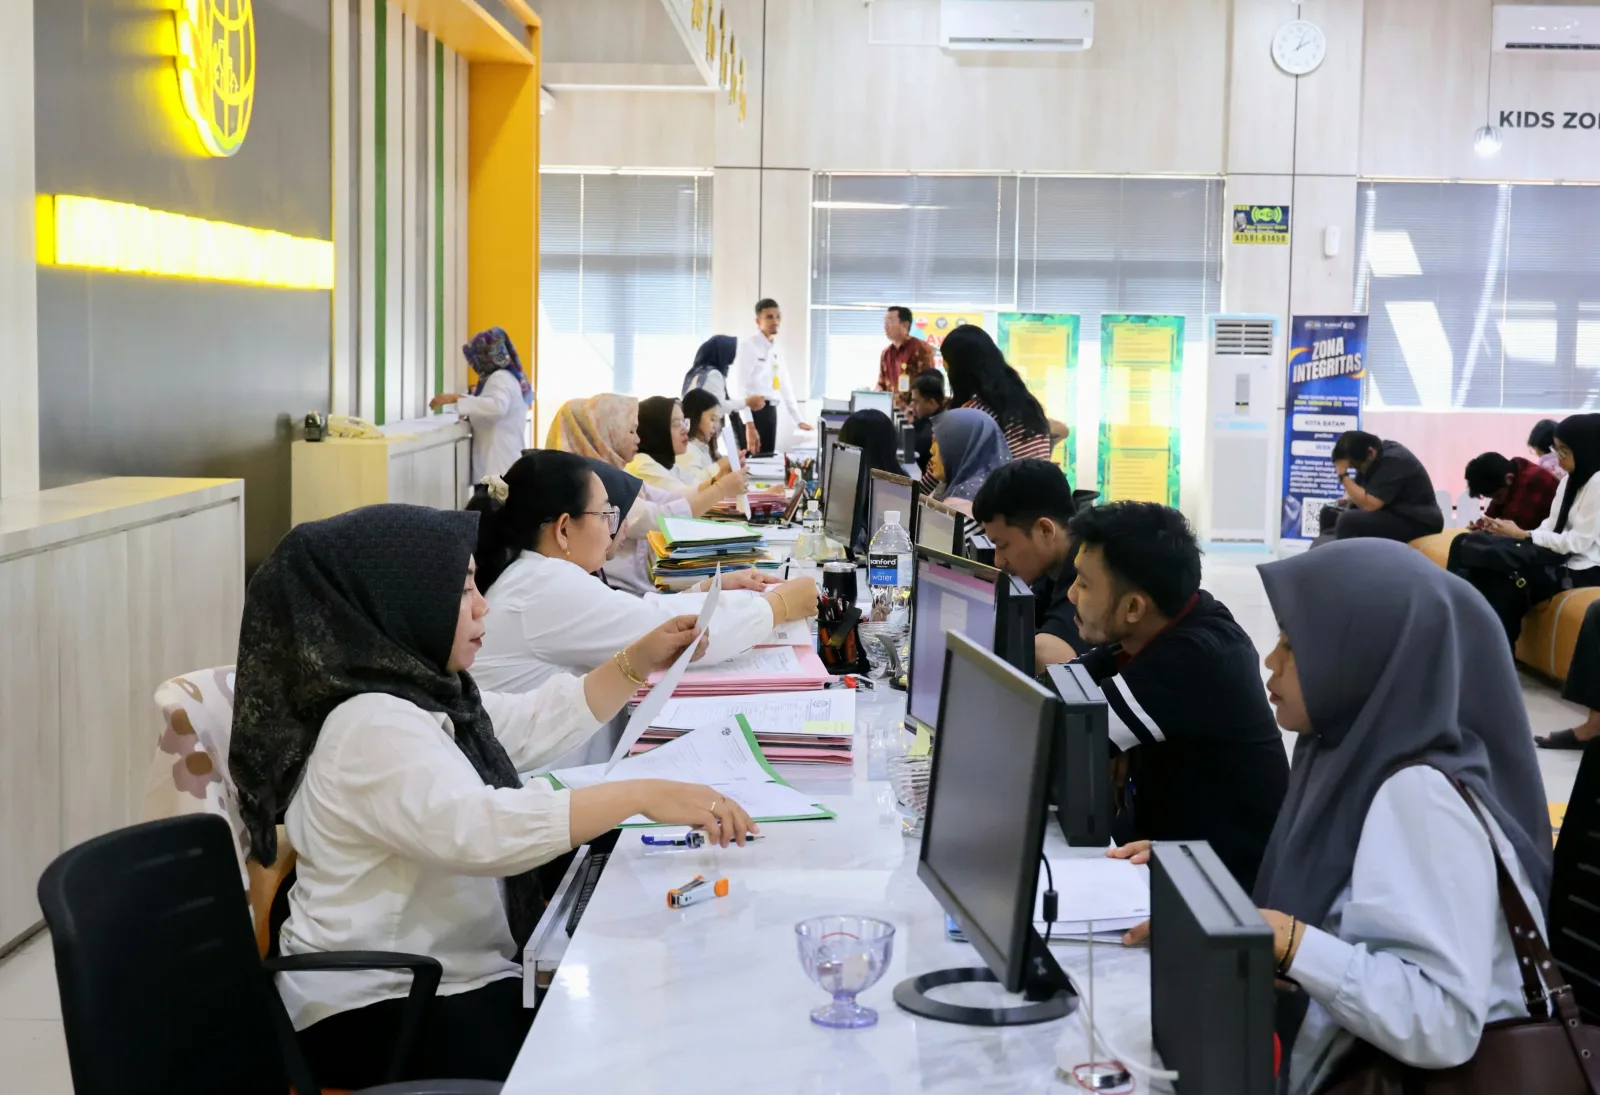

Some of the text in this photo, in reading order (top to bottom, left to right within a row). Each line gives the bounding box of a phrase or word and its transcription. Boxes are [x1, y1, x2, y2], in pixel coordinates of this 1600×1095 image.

[1499, 110, 1600, 130] KIDS ZO
[1312, 336, 1345, 360] ZONA
[1292, 352, 1362, 383] INTEGRITAS
